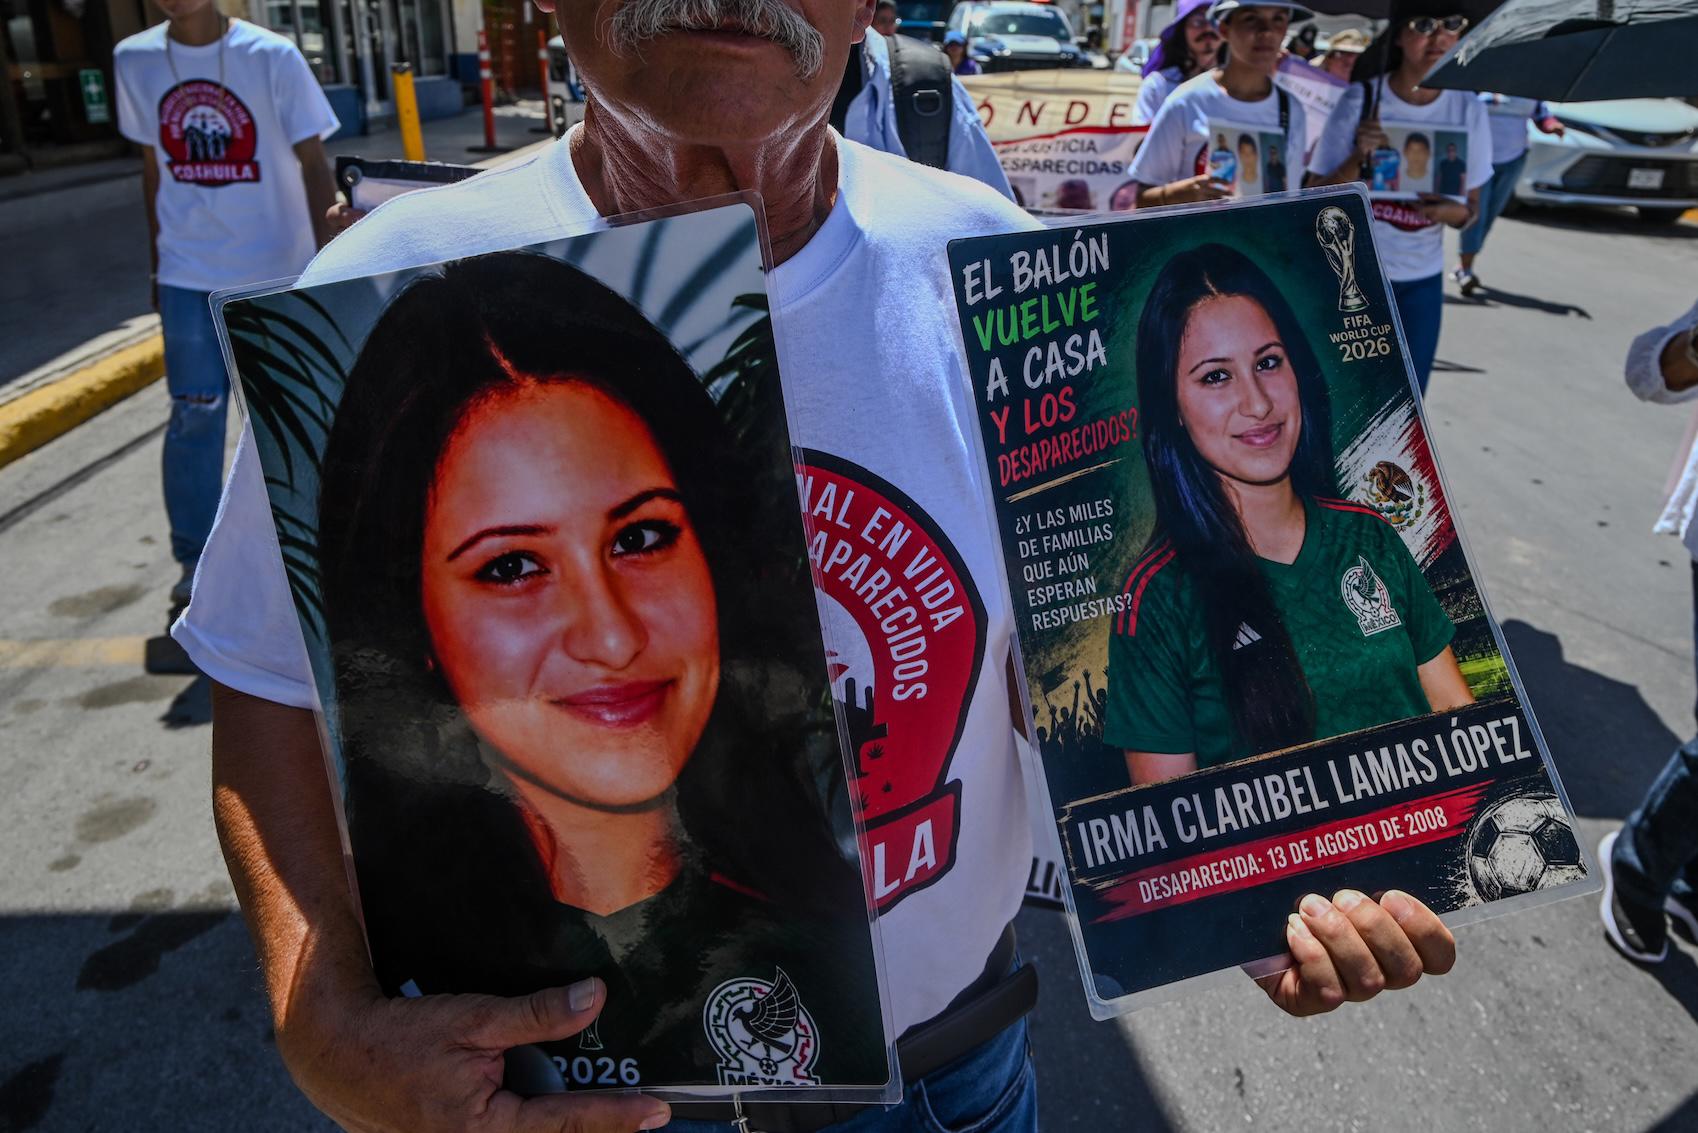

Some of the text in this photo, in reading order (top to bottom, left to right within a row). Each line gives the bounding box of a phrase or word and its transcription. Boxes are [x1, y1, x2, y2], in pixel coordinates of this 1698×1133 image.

[173, 164, 253, 180] COAHUILA
[963, 229, 1110, 306] EL BALÓN
[972, 282, 1099, 351] VUELVE
[1329, 324, 1392, 344] WORLD CUP
[1343, 314, 1372, 329] FIFA
[986, 328, 1107, 401] A CASA
[1339, 337, 1391, 363] 2026
[990, 385, 1077, 444] Y LOS
[998, 407, 1138, 487] DESAPARECIDOS?
[1015, 499, 1114, 535] ¿Y LAS MILES
[1018, 523, 1113, 559] DE FAMILIAS
[860, 506, 912, 560] EN
[903, 545, 965, 632] VIDA
[1023, 552, 1089, 583] QUE AÚN
[1027, 576, 1097, 607] ESPERAN
[1032, 592, 1132, 631] RESPUESTAS?
[1078, 715, 1532, 868] IRMA CLARIBEL LAMAS LÓPEZ
[874, 818, 936, 900] LA
[1138, 805, 1448, 903] DESAPARECIDA: 13 DE AGOSTO DE 2008
